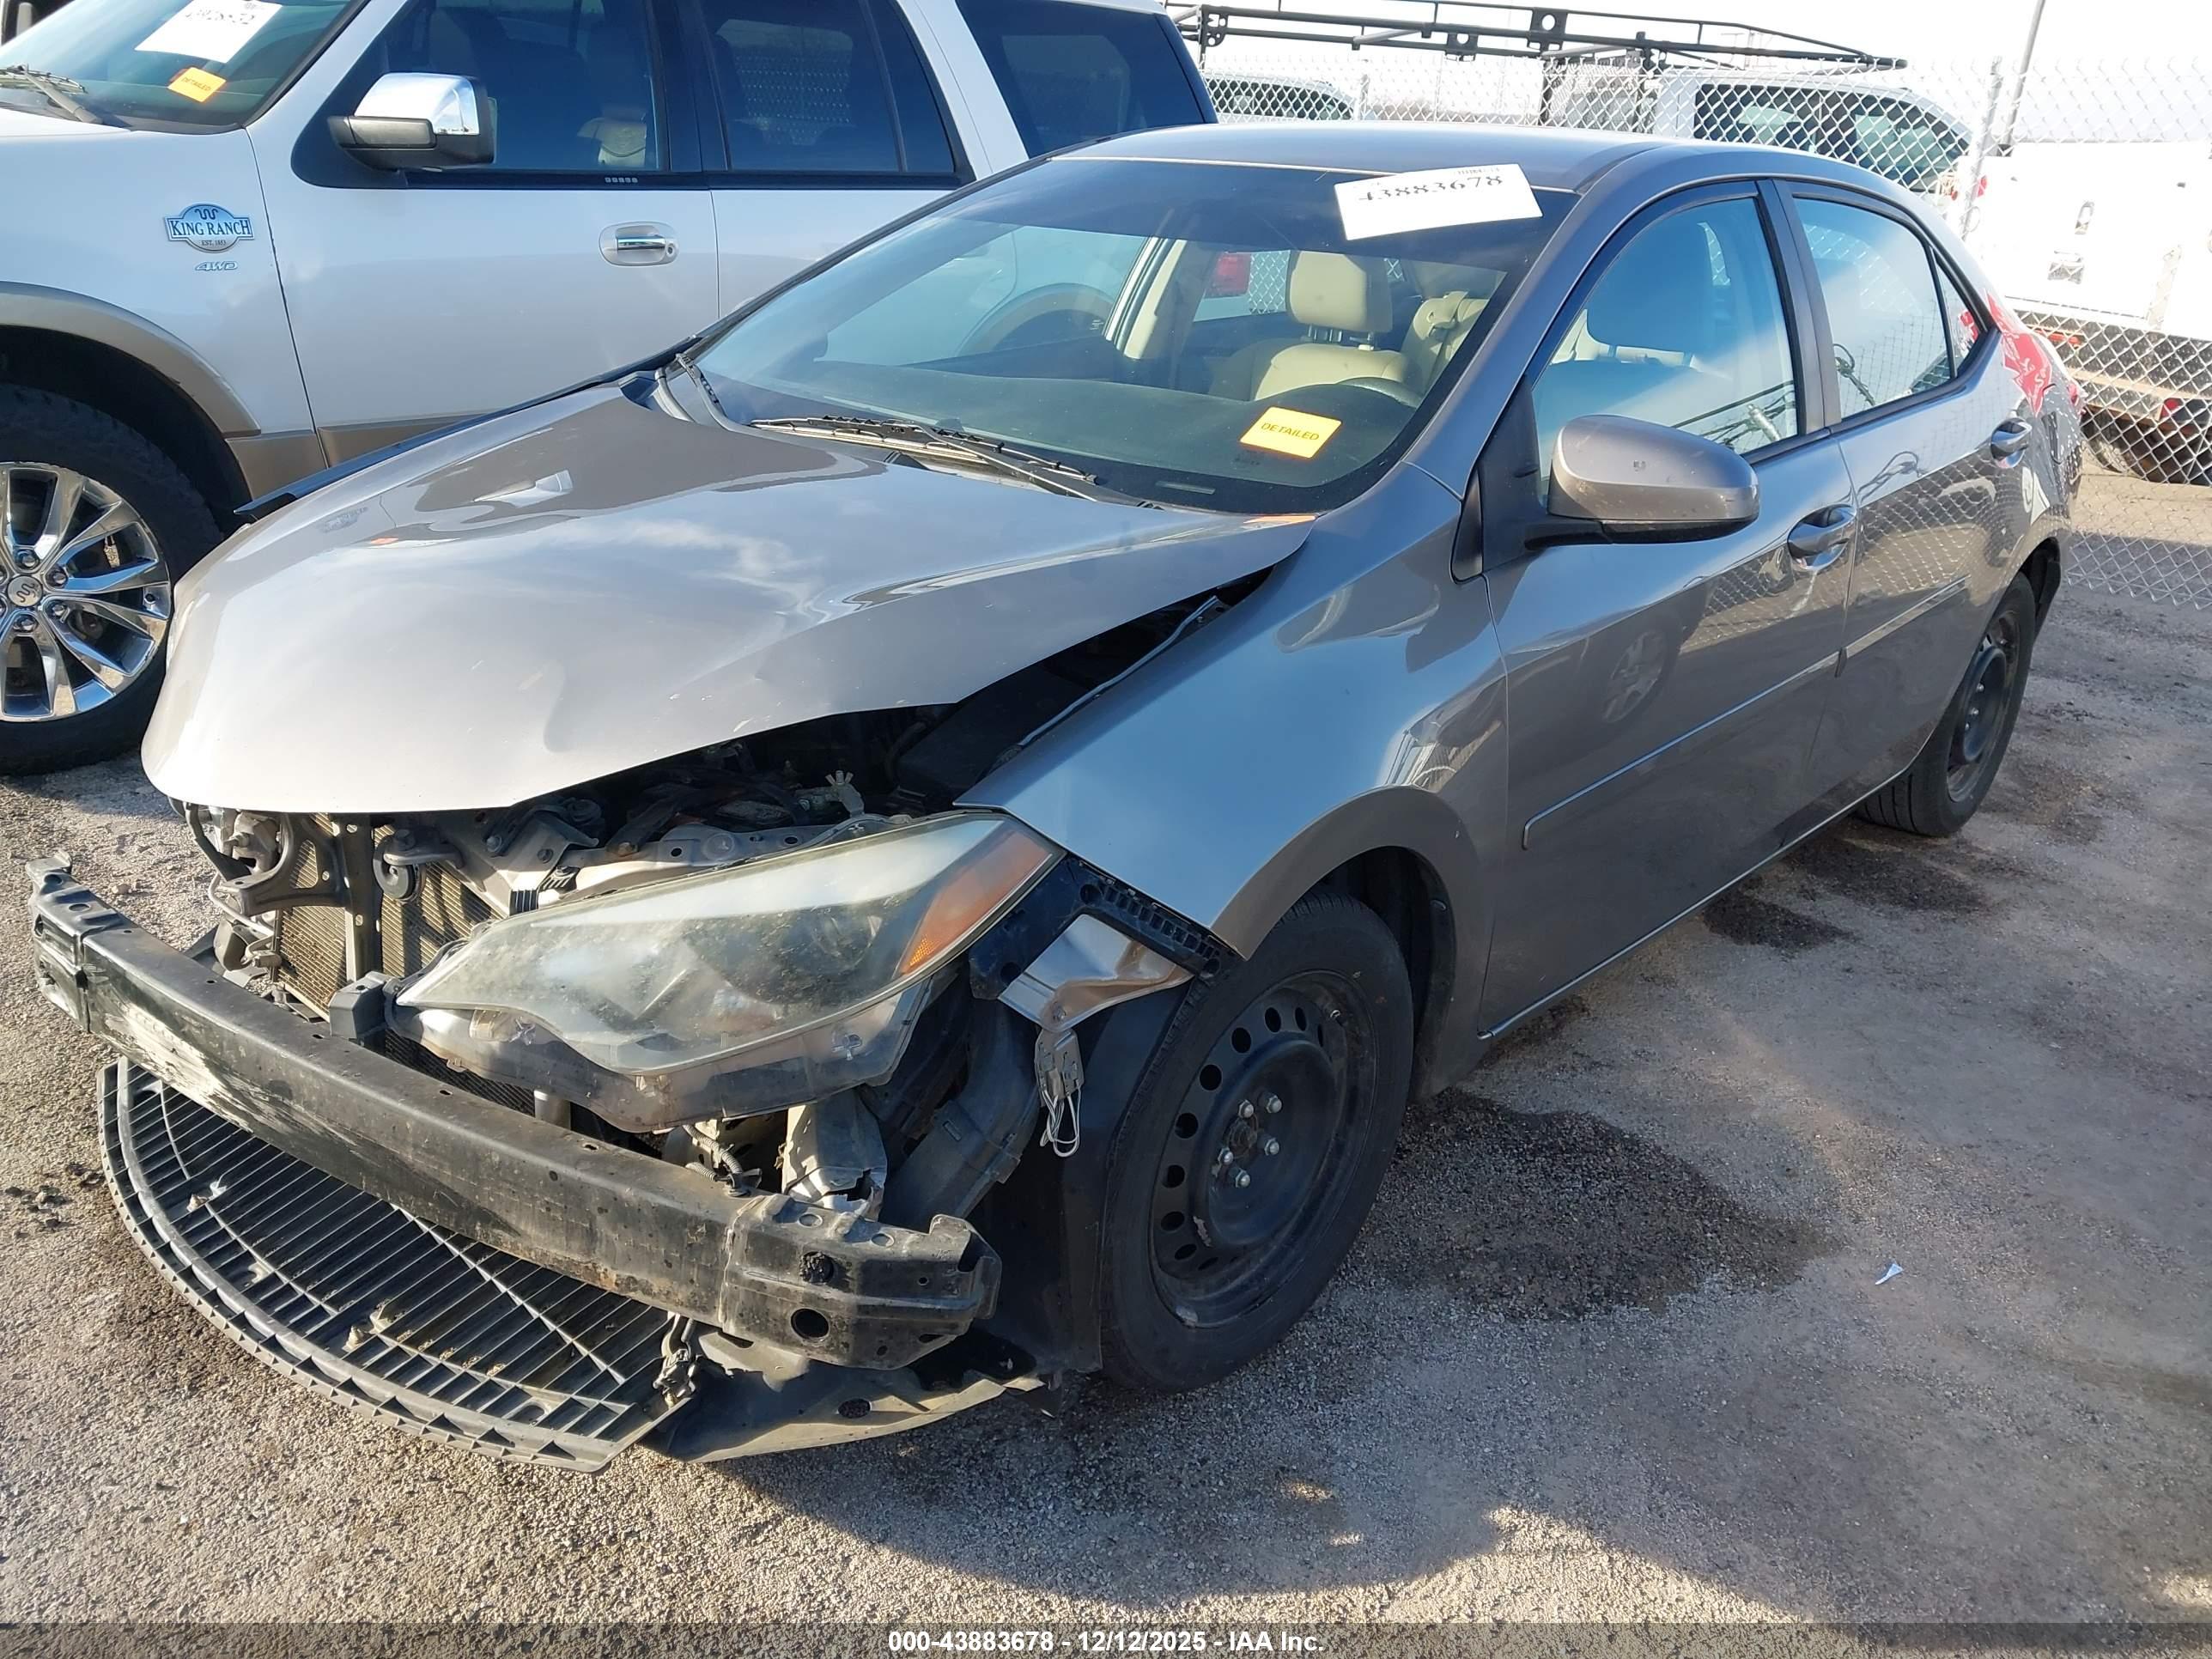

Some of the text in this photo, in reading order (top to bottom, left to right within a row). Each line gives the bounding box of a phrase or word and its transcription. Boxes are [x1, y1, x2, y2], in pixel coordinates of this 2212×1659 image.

[169, 219, 252, 236] KING RANCH
[195, 260, 238, 271] 4WD
[1261, 422, 1320, 441] DETAILED
